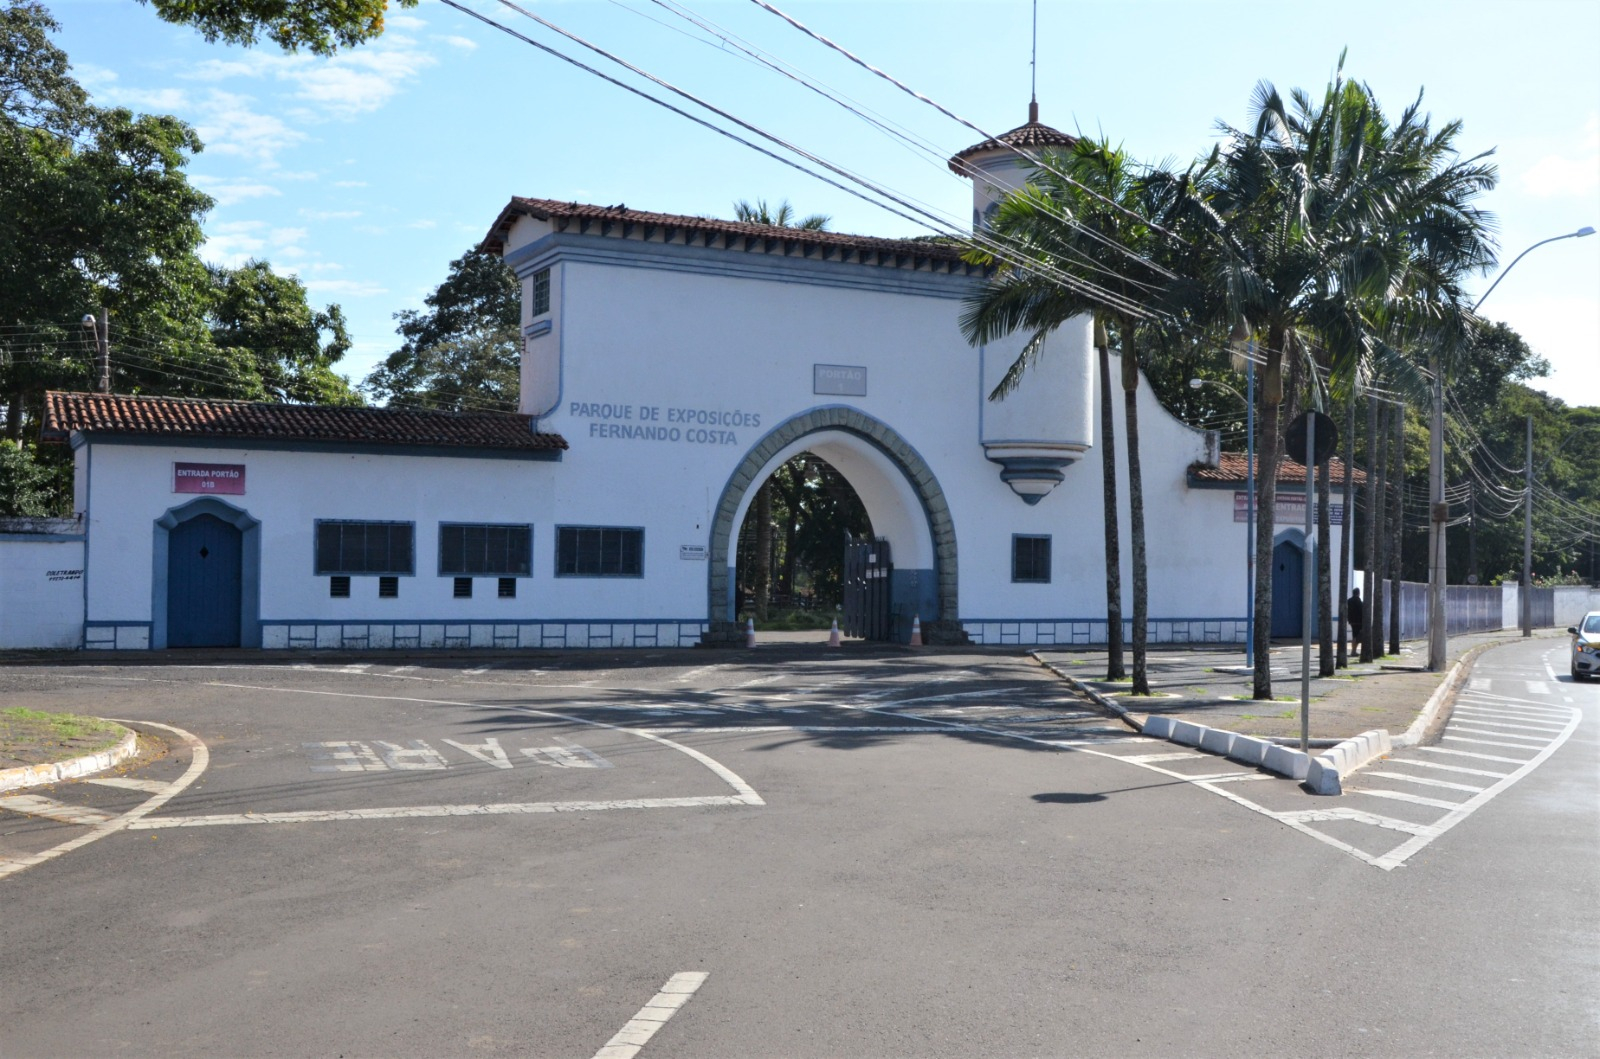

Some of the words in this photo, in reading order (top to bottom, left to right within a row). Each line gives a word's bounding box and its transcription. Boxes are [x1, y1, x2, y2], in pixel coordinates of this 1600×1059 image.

[570, 402, 632, 420] PARQUE
[640, 406, 660, 421] DE
[667, 408, 761, 428] EXPOSIÇÕES
[589, 423, 681, 442] FERNANDO
[686, 428, 738, 445] COSTA
[177, 469, 210, 477] ENTRADA
[211, 469, 240, 478] PORTÃO
[301, 737, 616, 772] PARE
